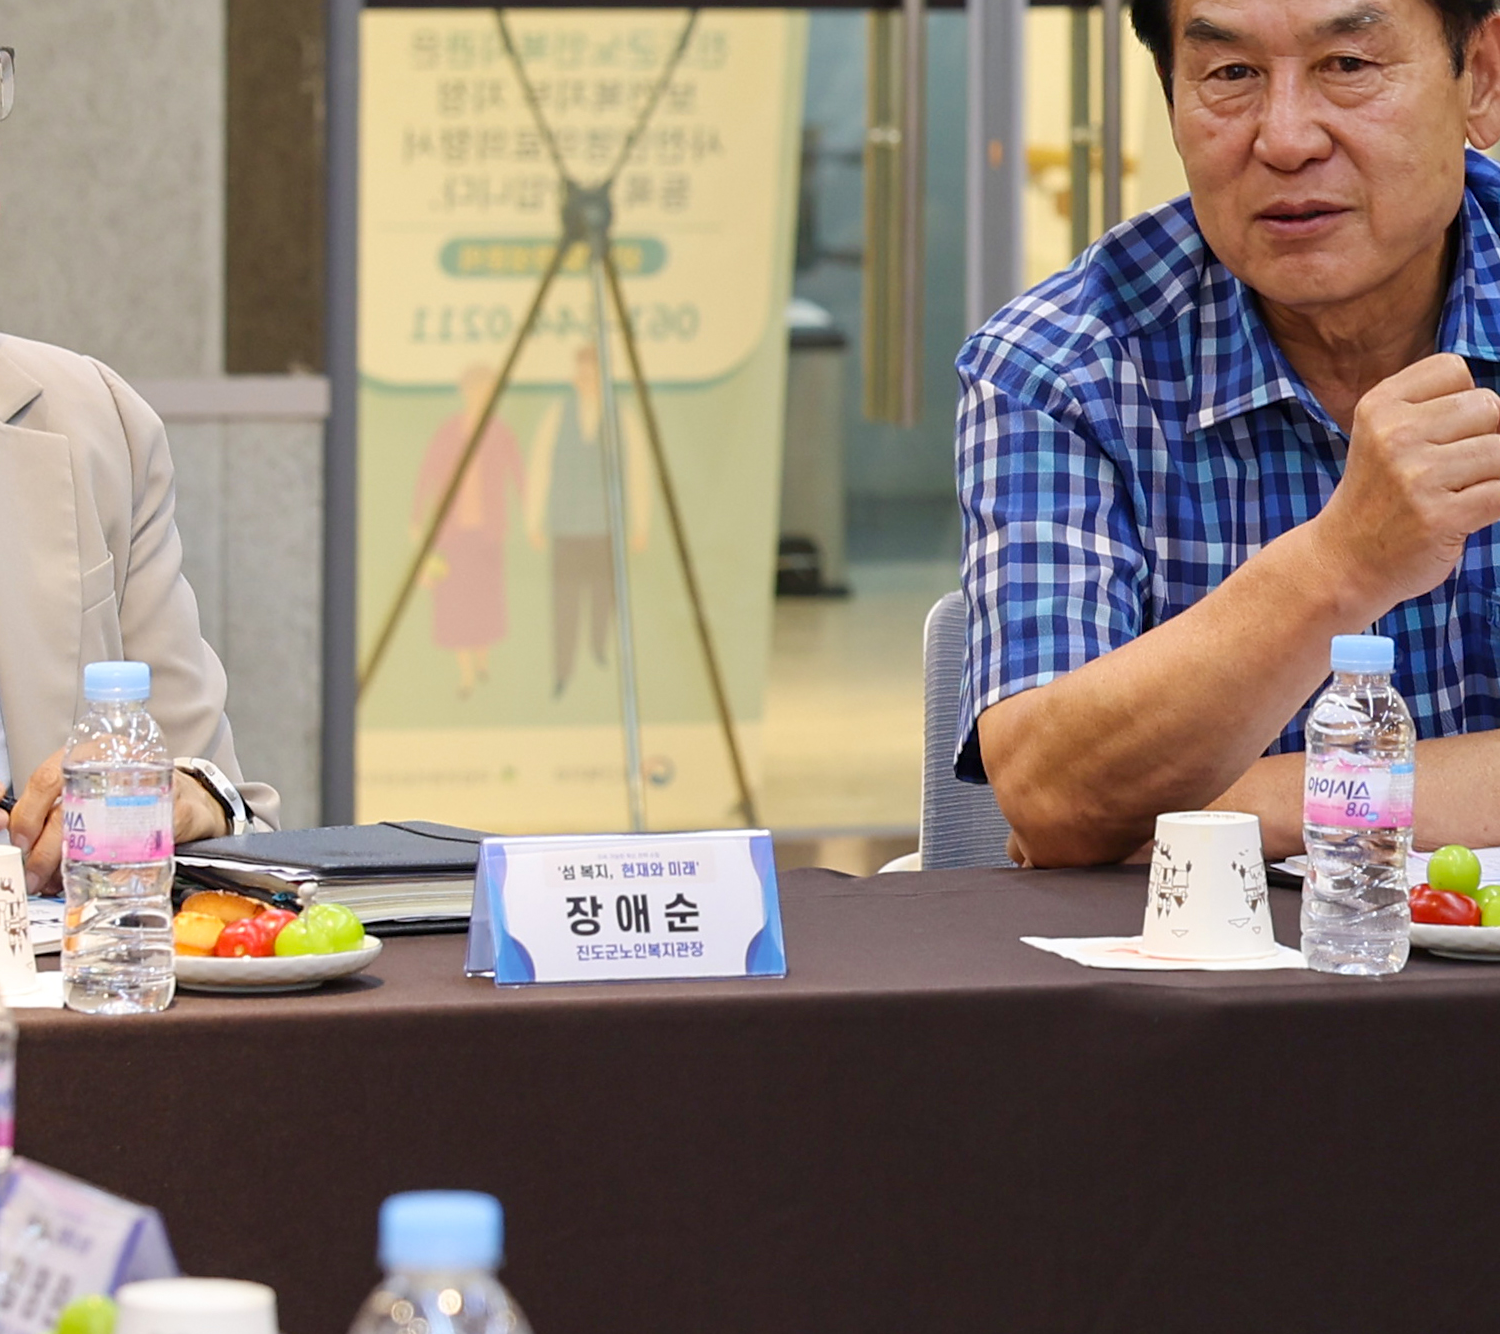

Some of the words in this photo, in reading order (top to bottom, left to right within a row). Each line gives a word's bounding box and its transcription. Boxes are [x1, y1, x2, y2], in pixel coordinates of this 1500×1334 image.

[1308, 776, 1371, 800] 아이시스
[1345, 802, 1370, 817] 8.0
[580, 863, 614, 881] 복지,
[621, 862, 665, 879] 현재와
[576, 941, 704, 962] 진도군노인복지관장
